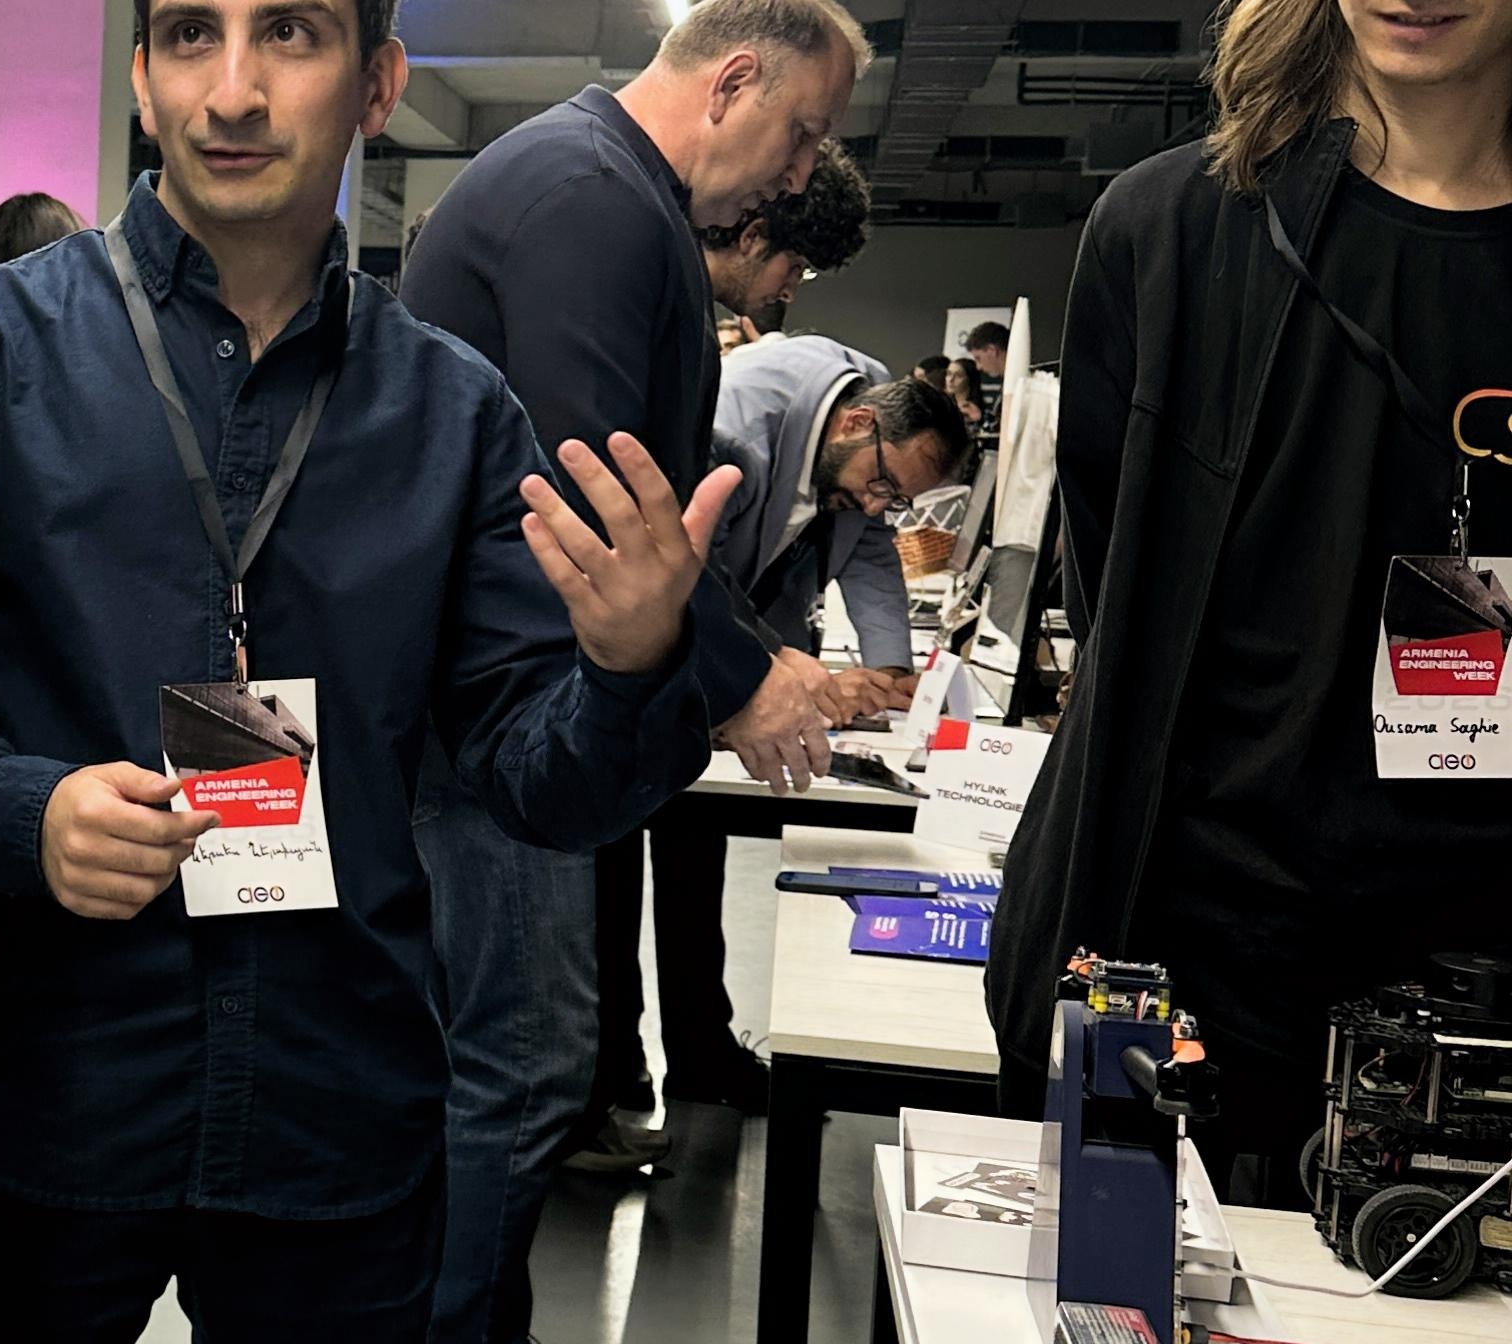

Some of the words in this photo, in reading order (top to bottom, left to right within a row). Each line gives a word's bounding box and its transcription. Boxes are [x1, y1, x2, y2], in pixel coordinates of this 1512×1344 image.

[1399, 648, 1469, 658] ARMENIA
[1398, 660, 1496, 670] ENGINEERING
[1452, 671, 1496, 681] WEEK
[194, 778, 269, 791] ARMENIA
[963, 781, 1008, 796] HYLINK
[195, 788, 297, 803] ENGINEERING
[254, 799, 298, 811] WEEK
